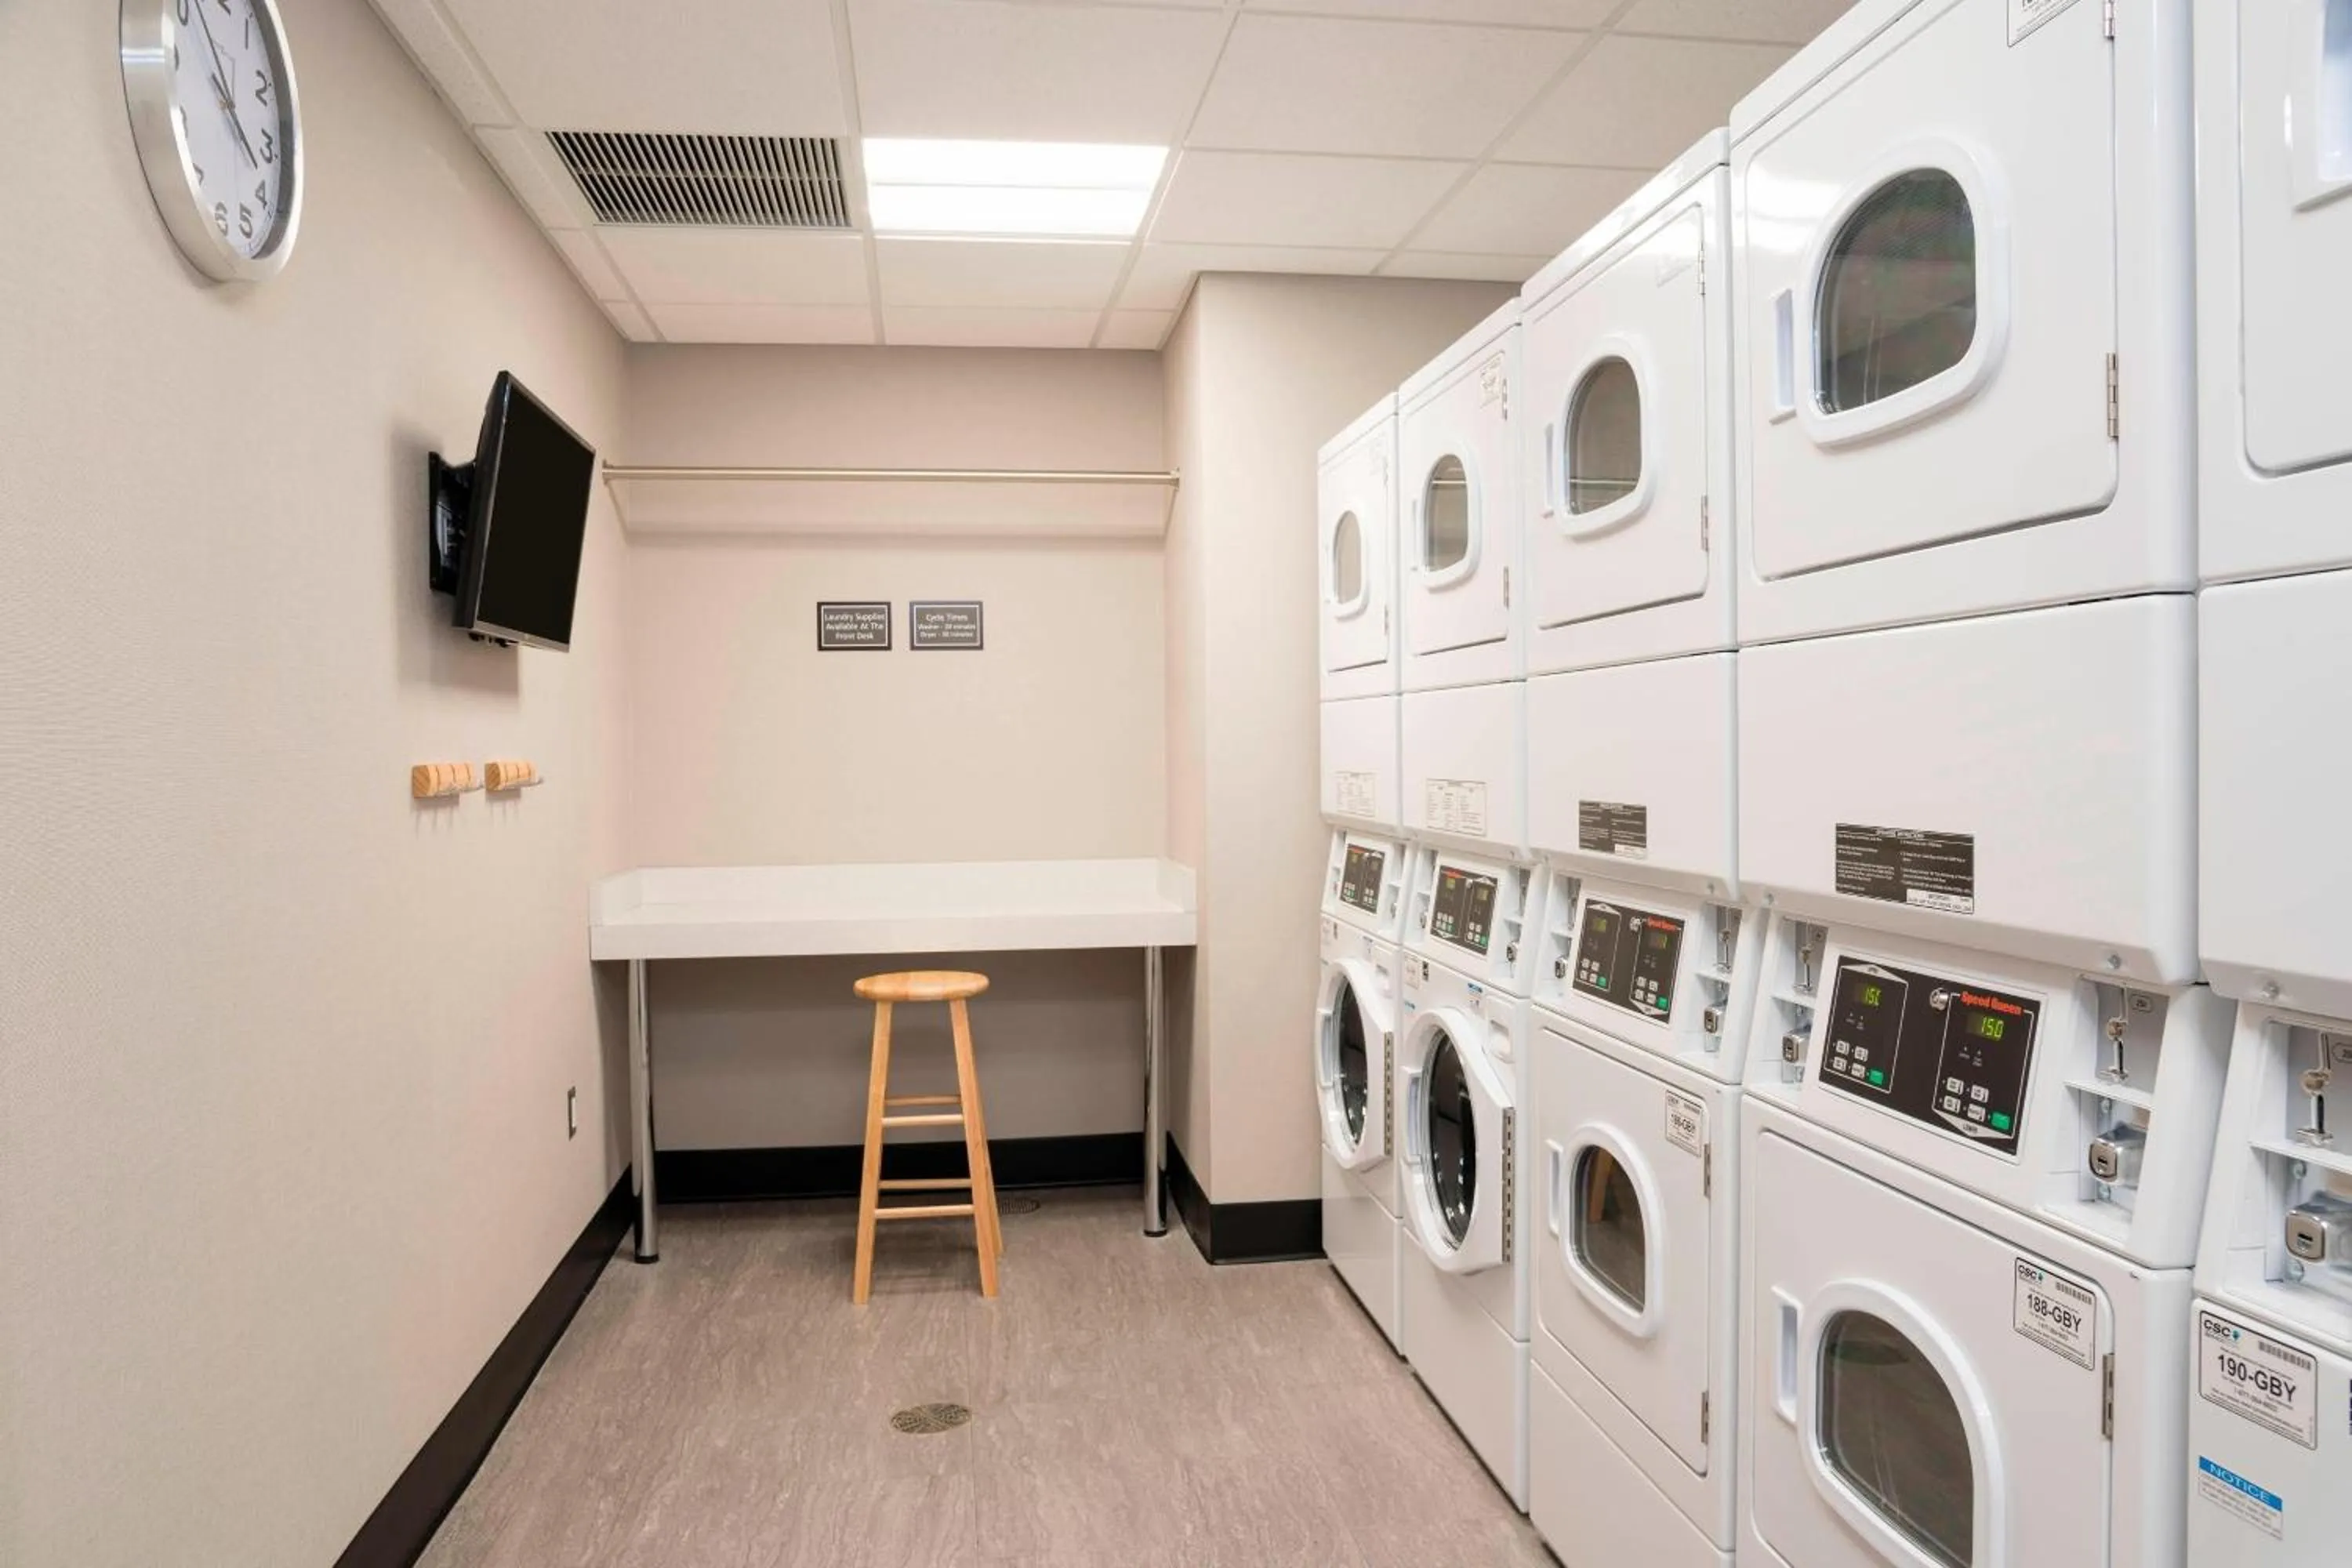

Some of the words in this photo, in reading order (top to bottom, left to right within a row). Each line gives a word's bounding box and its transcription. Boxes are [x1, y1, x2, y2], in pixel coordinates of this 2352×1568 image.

[255, 70, 268, 107] 2
[260, 129, 274, 164] 3
[255, 180, 267, 209] 4
[238, 202, 252, 239] 5
[1981, 1016, 2004, 1039] 150
[2017, 1265, 2038, 1280] CSC
[2027, 1294, 2082, 1333] 188-GBY
[2204, 1319, 2230, 1337] CSC
[2218, 1354, 2296, 1403] 190-GBY
[2210, 1464, 2270, 1506] NOTICE
